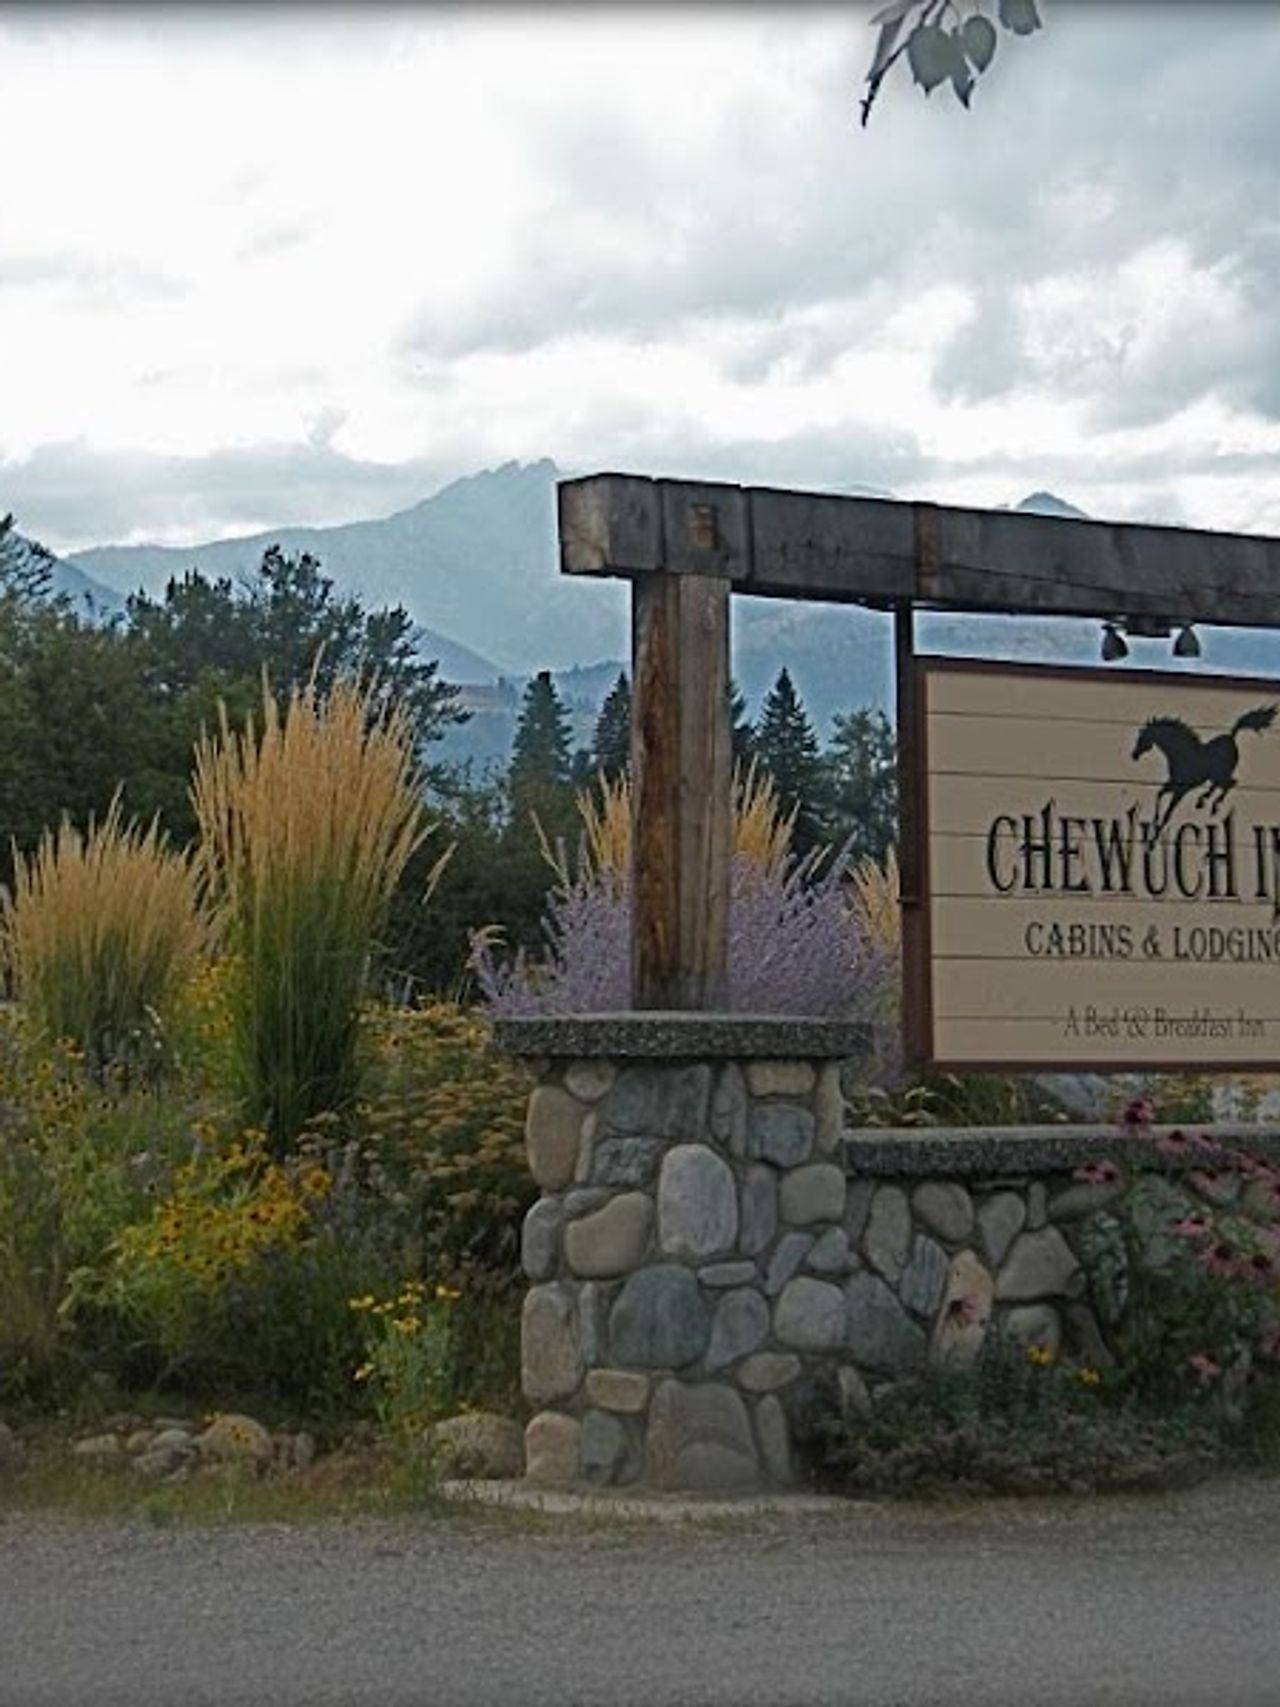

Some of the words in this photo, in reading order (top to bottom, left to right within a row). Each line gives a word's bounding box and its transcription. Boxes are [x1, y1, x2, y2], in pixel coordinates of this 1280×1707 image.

[987, 797, 1238, 898] CHEWUCH
[1024, 921, 1133, 957] CABINS
[1142, 923, 1161, 957] &
[1155, 1007, 1233, 1038] Breakfast
